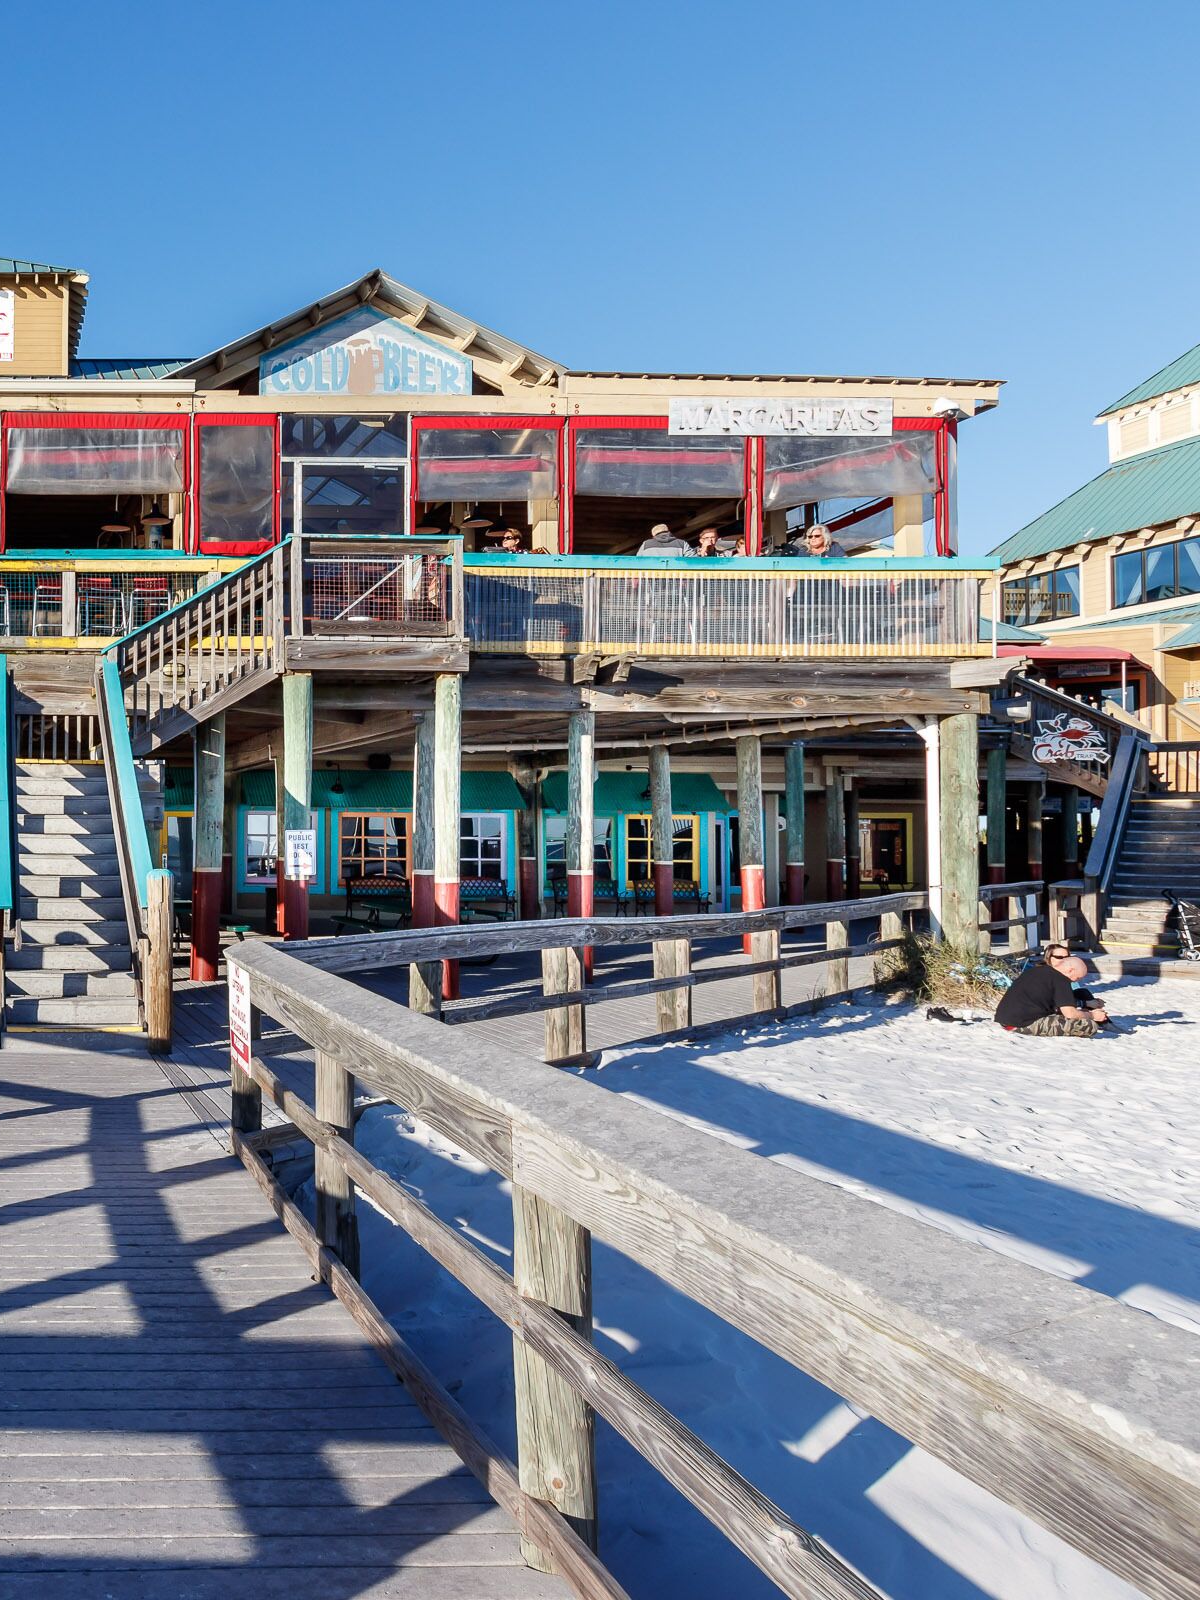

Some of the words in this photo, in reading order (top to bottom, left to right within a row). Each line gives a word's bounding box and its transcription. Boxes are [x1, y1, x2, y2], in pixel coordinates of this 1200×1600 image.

[270, 345, 350, 393] COLD
[379, 336, 463, 393] BEER
[678, 405, 881, 435] MARGARITAS
